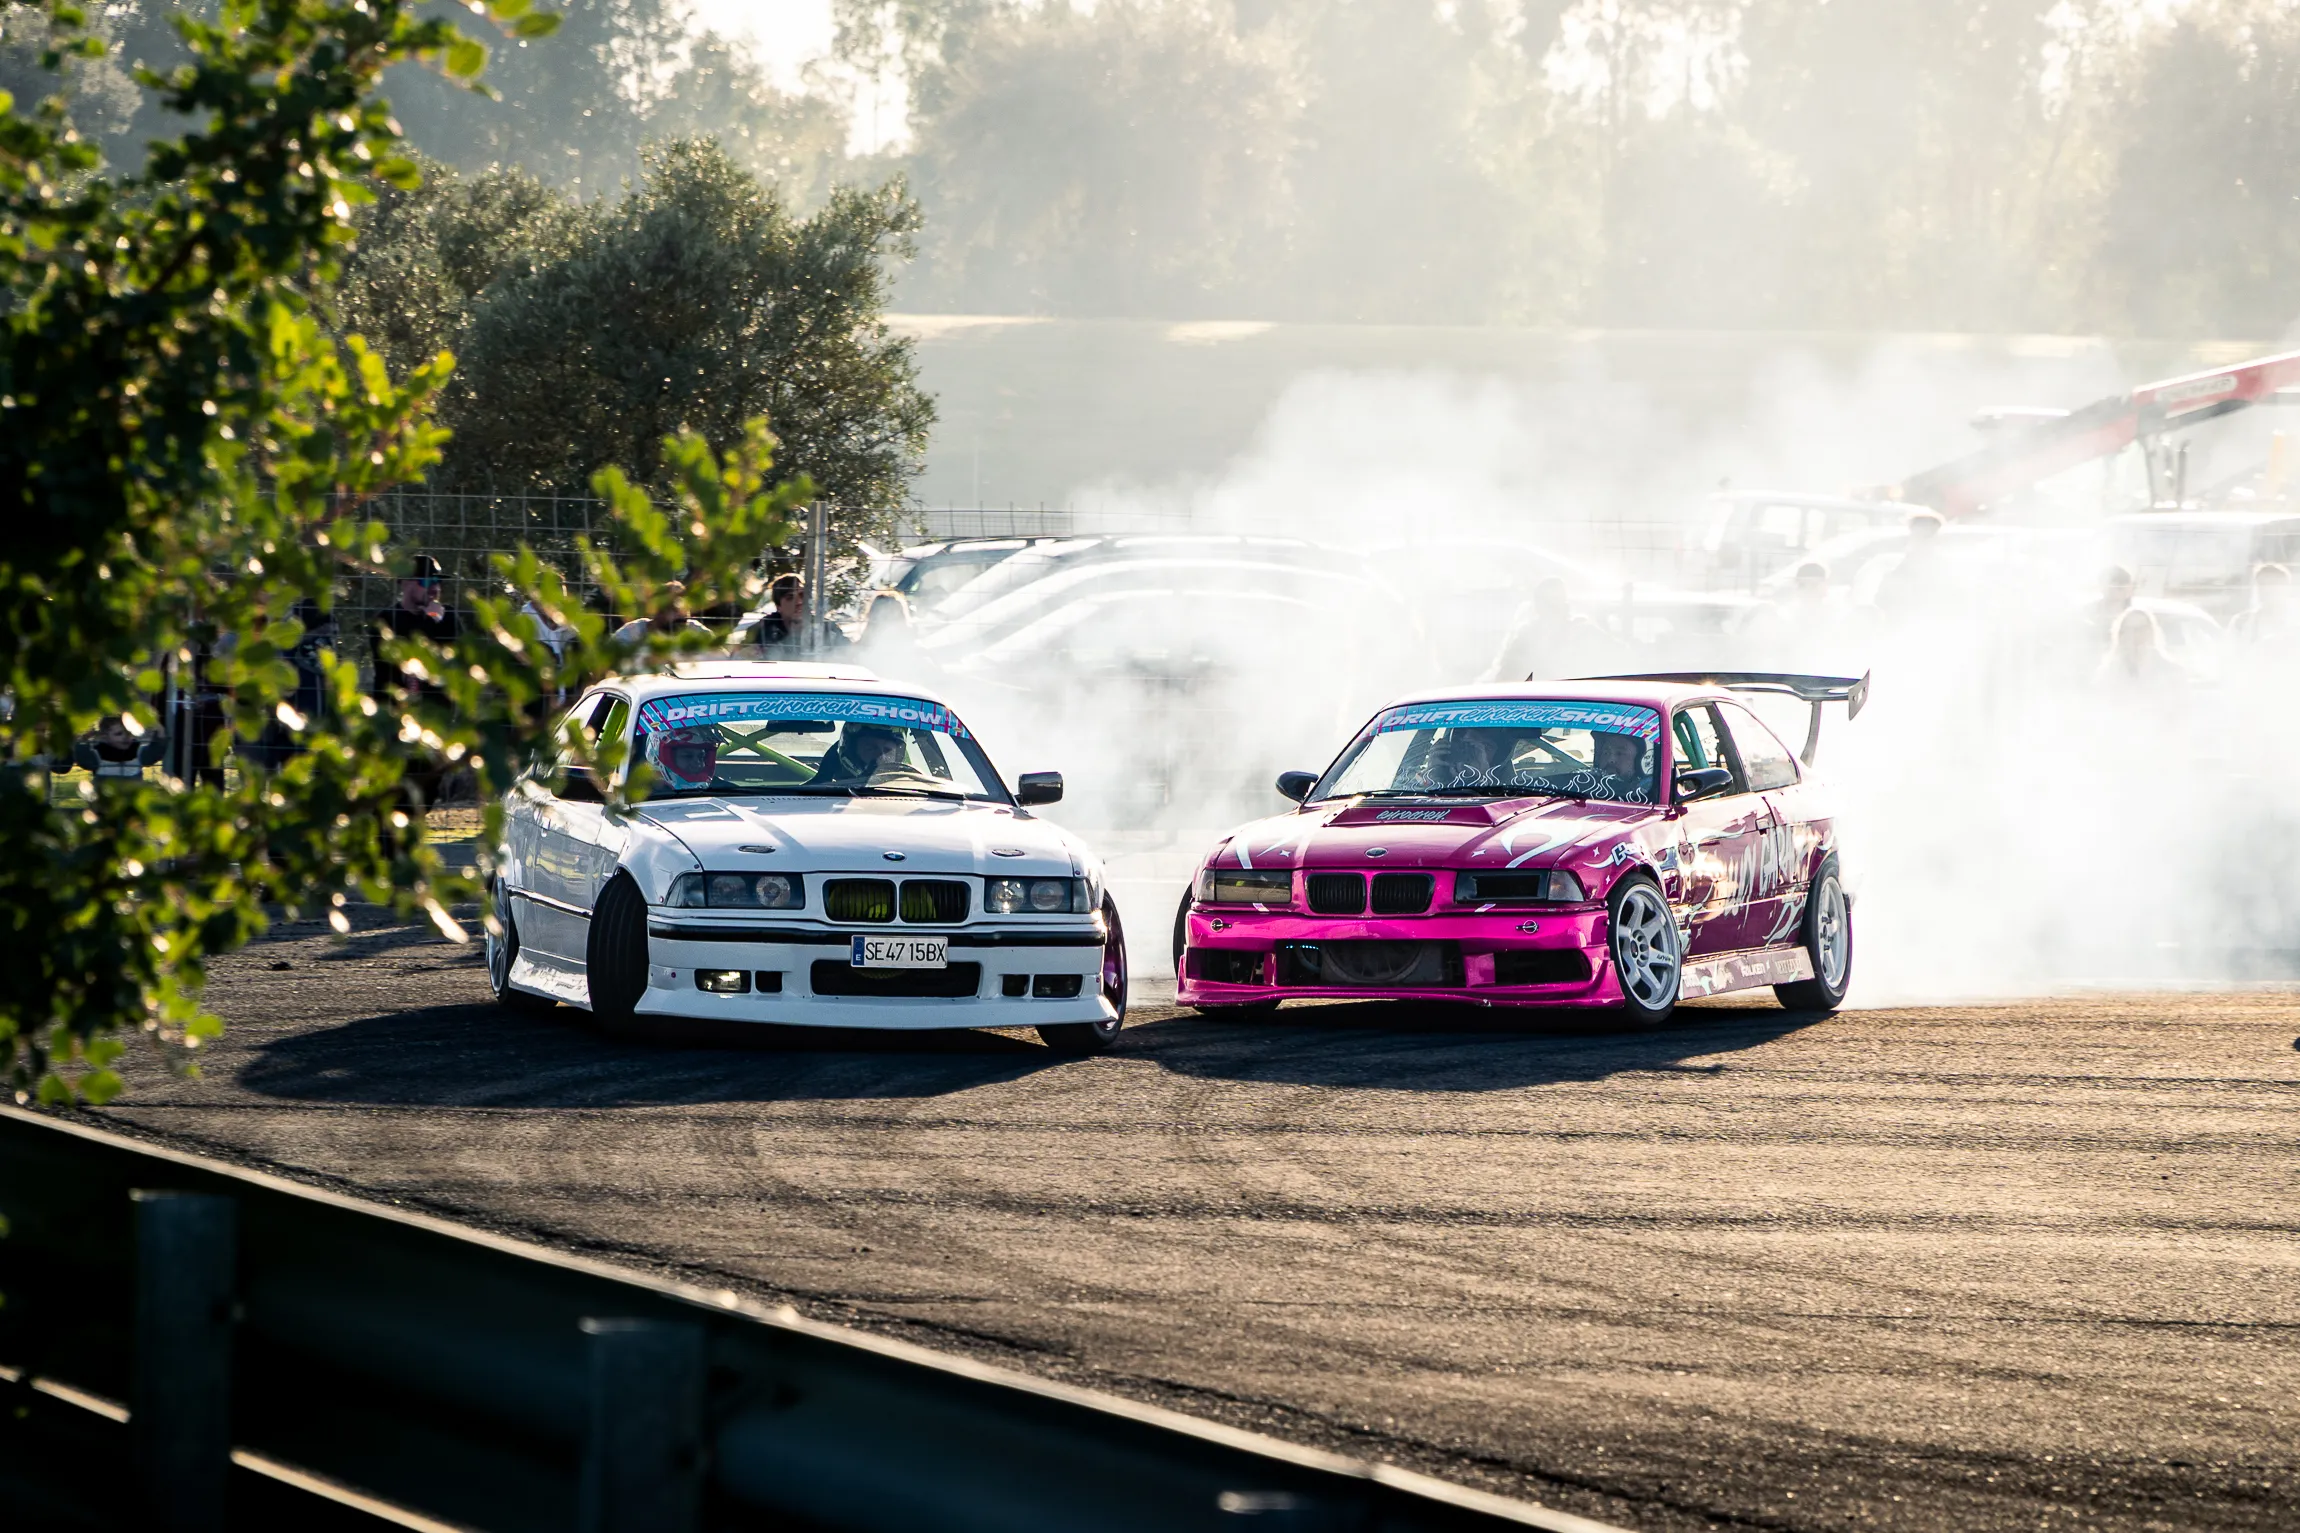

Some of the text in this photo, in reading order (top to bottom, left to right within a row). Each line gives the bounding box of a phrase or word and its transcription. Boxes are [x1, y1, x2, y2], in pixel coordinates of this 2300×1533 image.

[667, 701, 761, 721] DRIFT
[858, 704, 942, 725] SHOW
[1384, 709, 1470, 727] DRIFT
[1558, 711, 1641, 727] SHOW
[865, 942, 946, 961] SE4715BX
